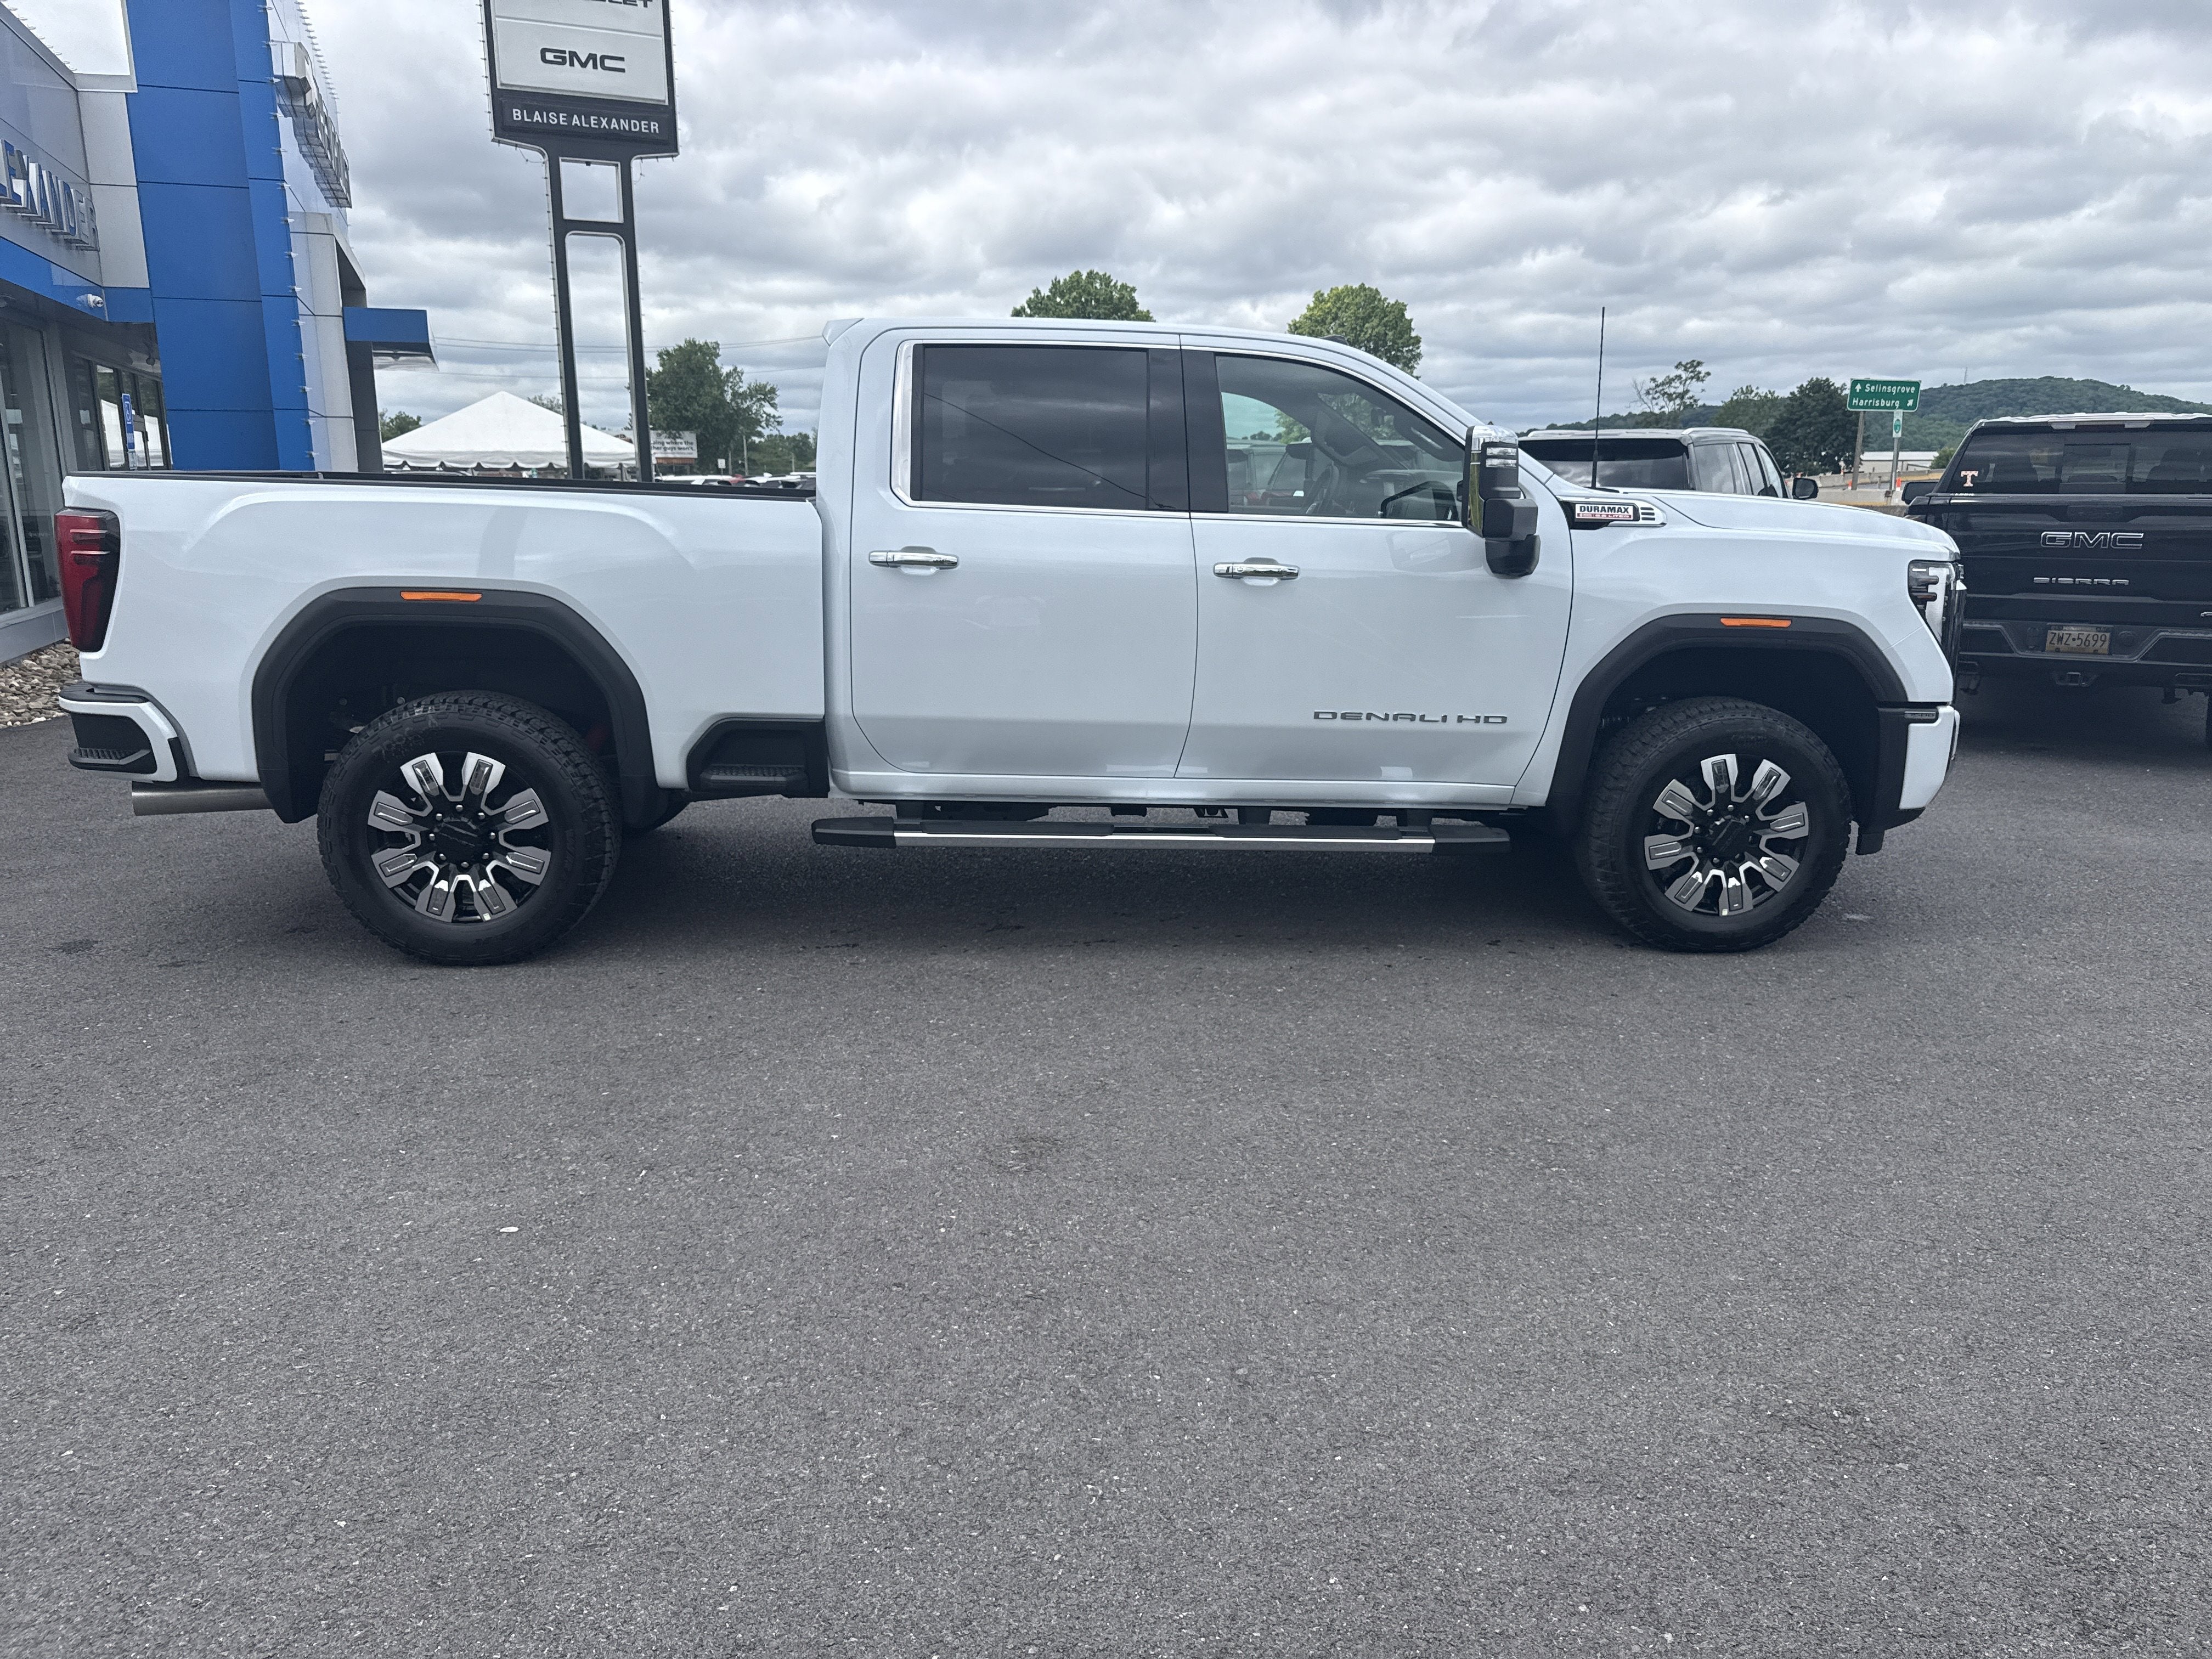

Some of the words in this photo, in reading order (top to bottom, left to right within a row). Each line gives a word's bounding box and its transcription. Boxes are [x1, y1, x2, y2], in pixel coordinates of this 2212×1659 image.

[540, 47, 625, 73] GMC
[512, 109, 568, 126] BLAISE
[572, 114, 659, 134] ALEXANDER
[0, 139, 100, 251] EXANDER
[1865, 383, 1915, 395] Selinsgrove
[1852, 398, 1900, 409] Harrisburg
[1579, 505, 1629, 514] DURAMAX
[2041, 532, 2144, 549] GMC
[2033, 577, 2130, 585] SIERRA
[1313, 710, 1447, 724] DENALI
[1457, 714, 1508, 724] HD
